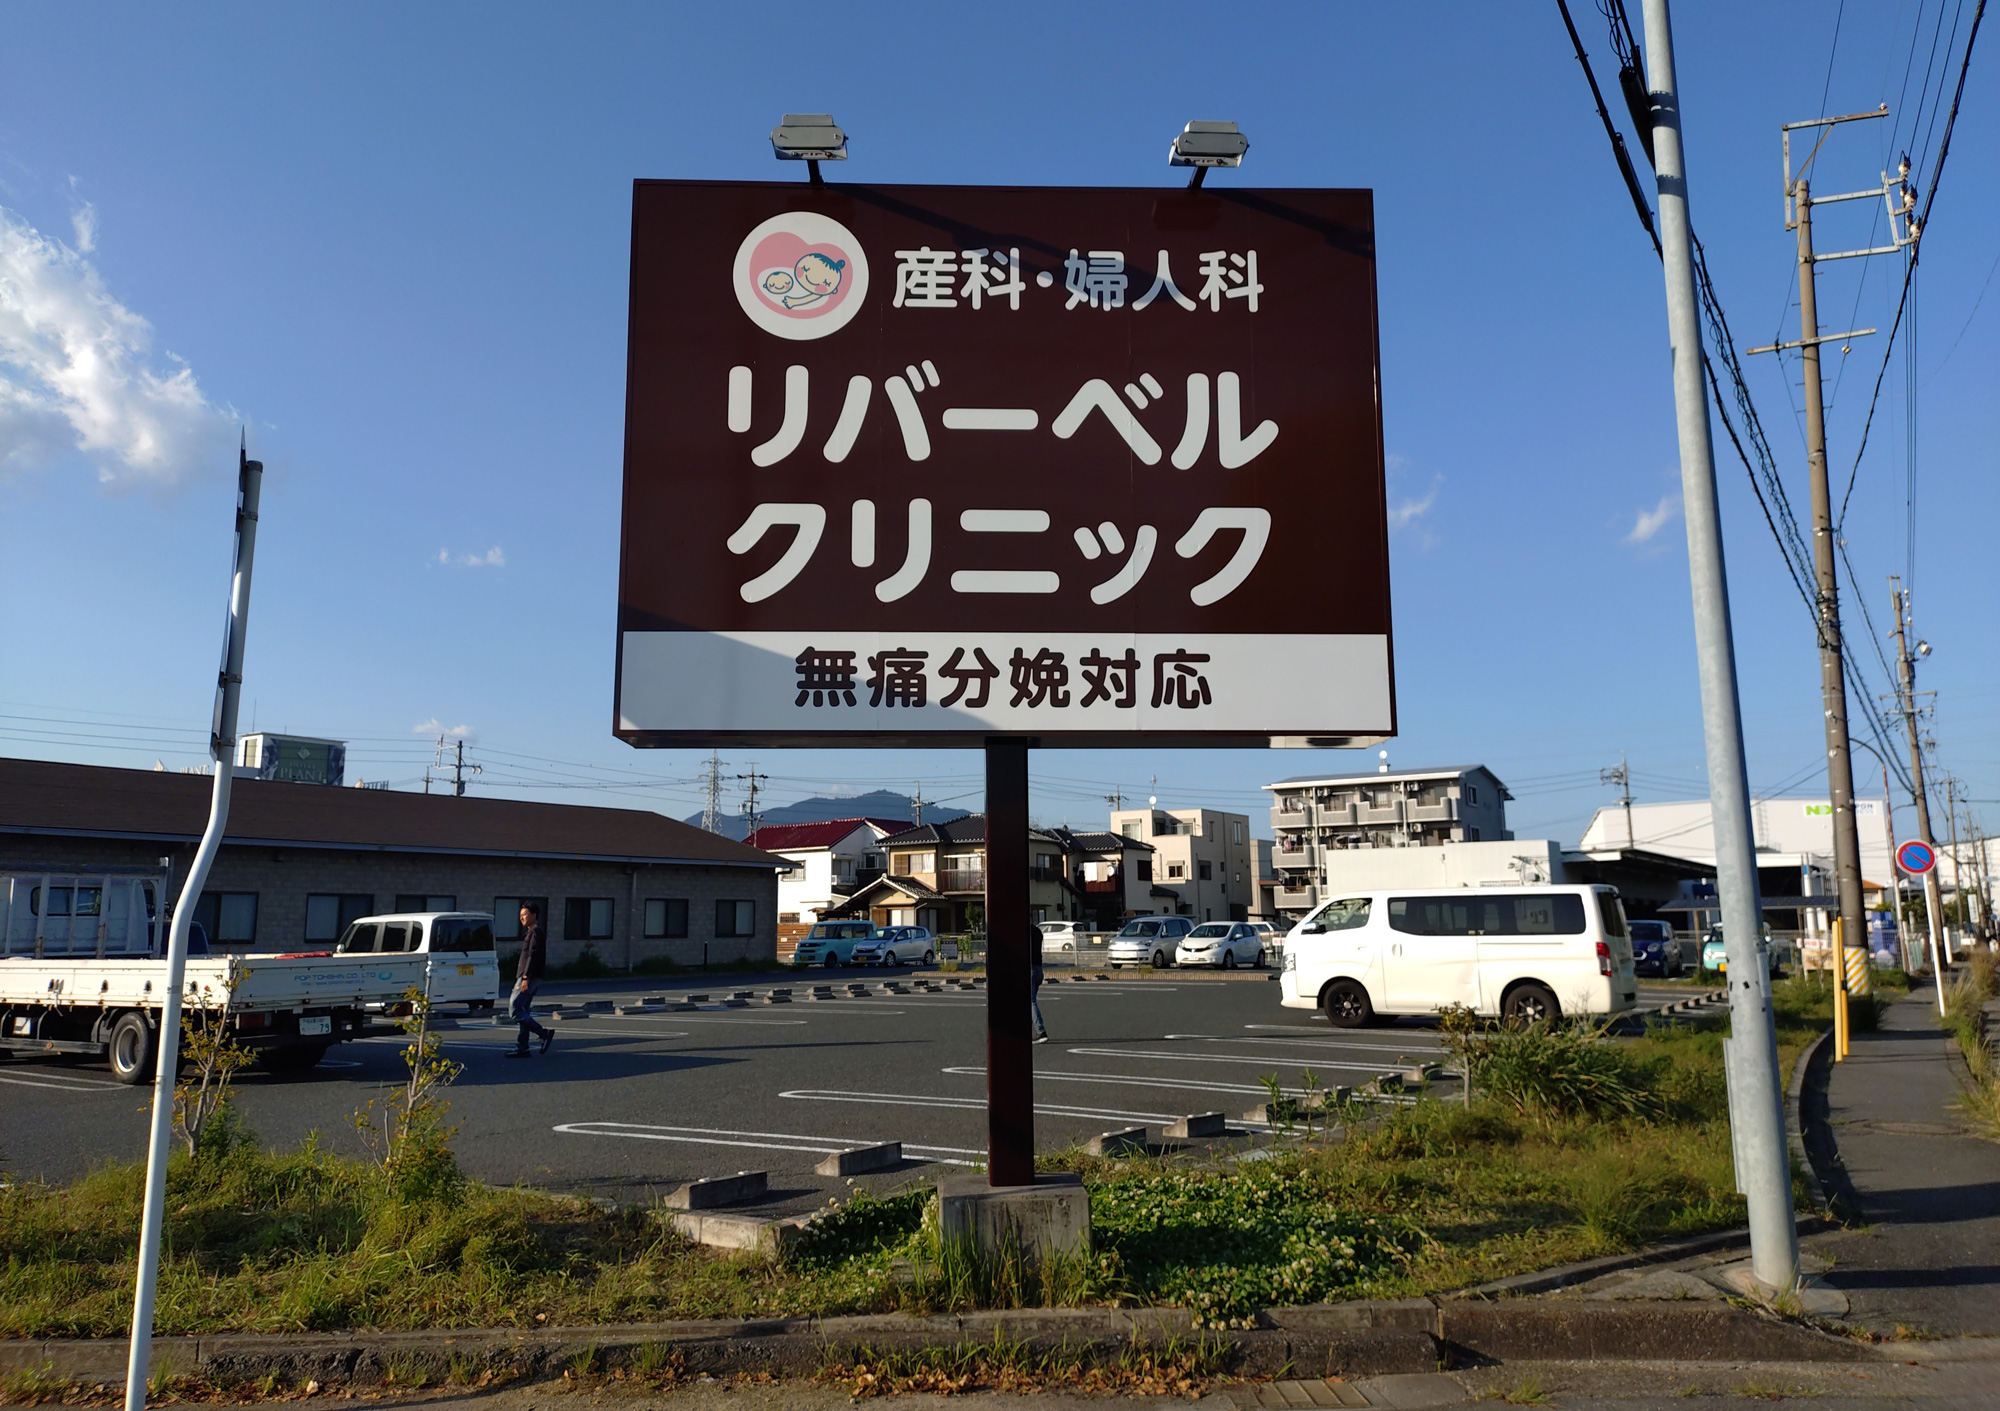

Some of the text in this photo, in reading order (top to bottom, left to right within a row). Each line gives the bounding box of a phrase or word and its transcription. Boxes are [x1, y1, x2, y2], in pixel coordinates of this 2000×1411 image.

[892, 246, 1265, 313] 産科・婦人科
[727, 359, 1279, 471] リバーベル
[726, 497, 1272, 607] クリニック
[794, 646, 1213, 709] 無痛分娩対応
